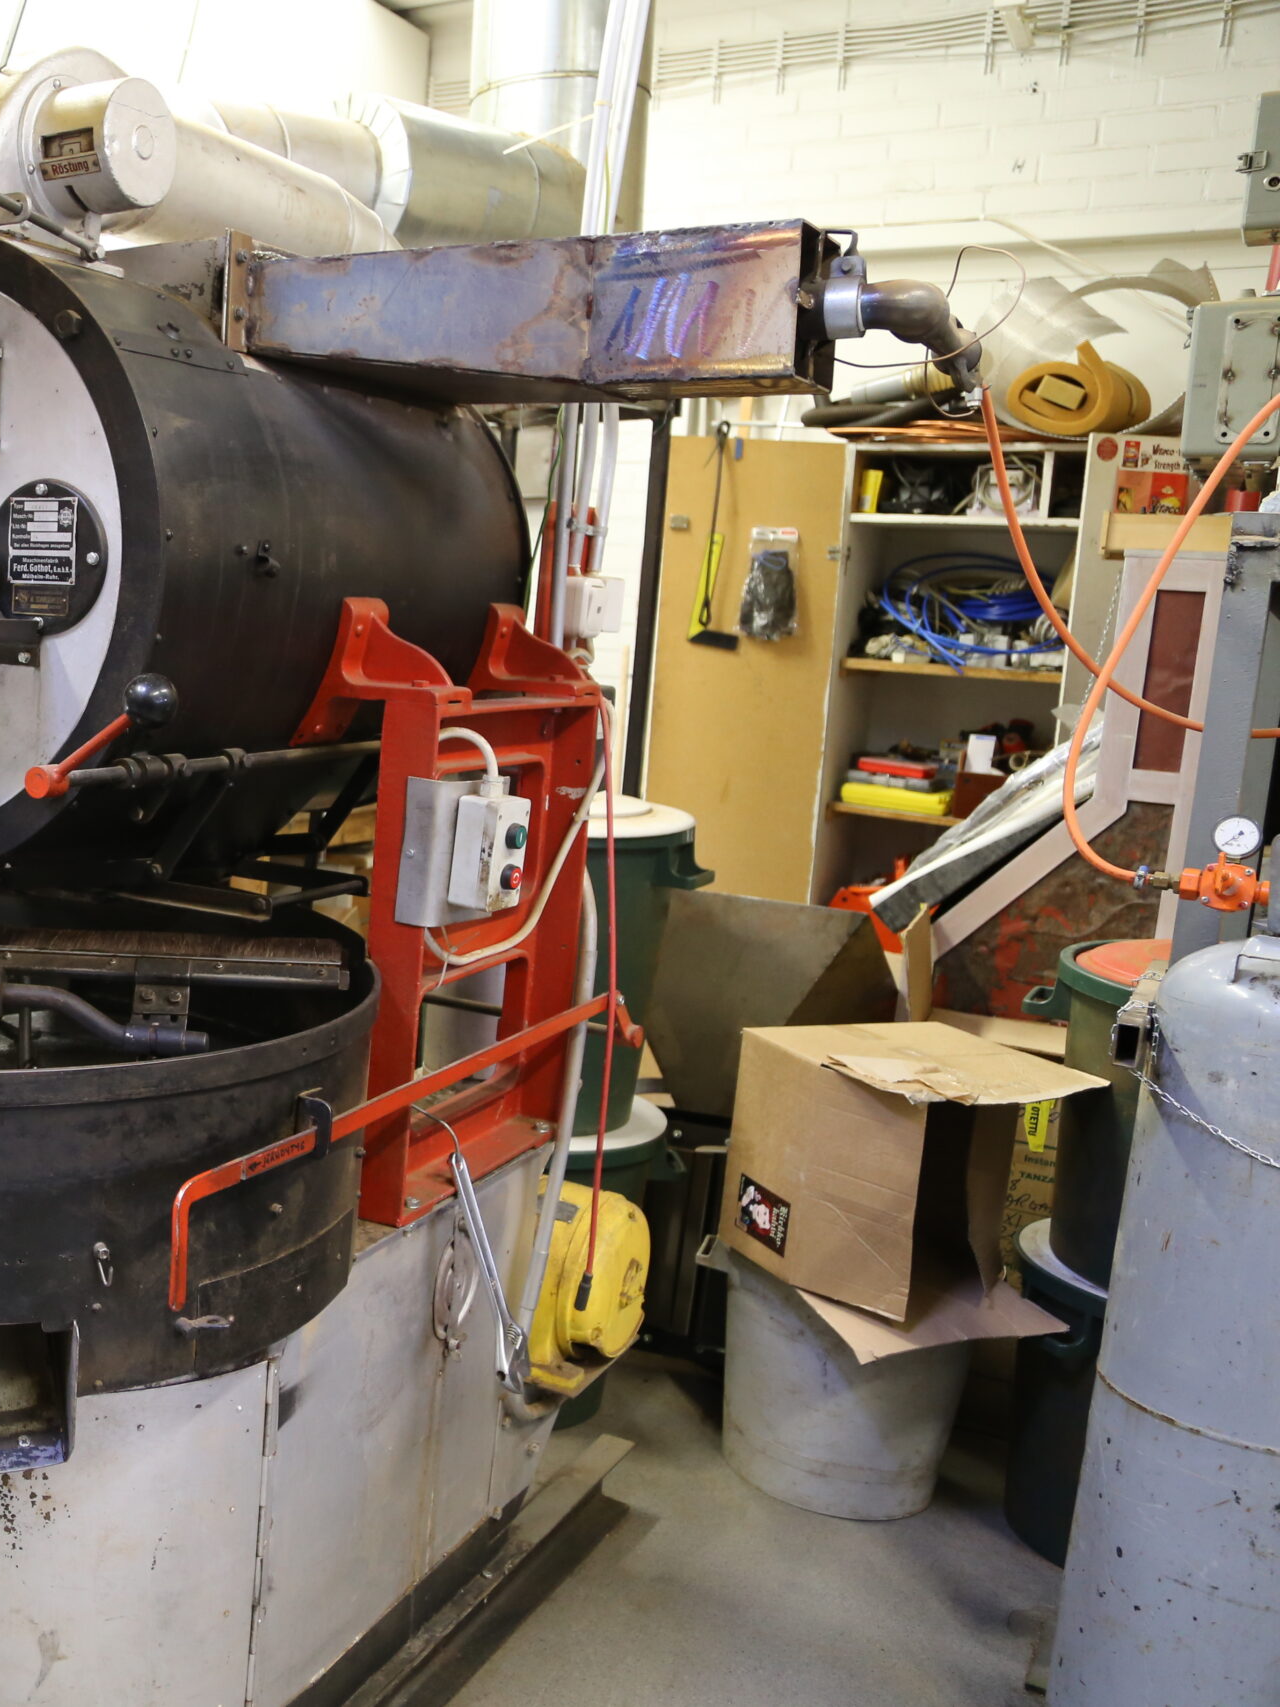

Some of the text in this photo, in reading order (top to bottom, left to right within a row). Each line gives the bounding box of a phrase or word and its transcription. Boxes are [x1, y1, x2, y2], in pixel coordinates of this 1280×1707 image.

[51, 160, 89, 176] Röstung
[1154, 462, 1180, 472] Strength
[13, 563, 28, 572] Ferd.
[1028, 1106, 1041, 1137] OTETTU
